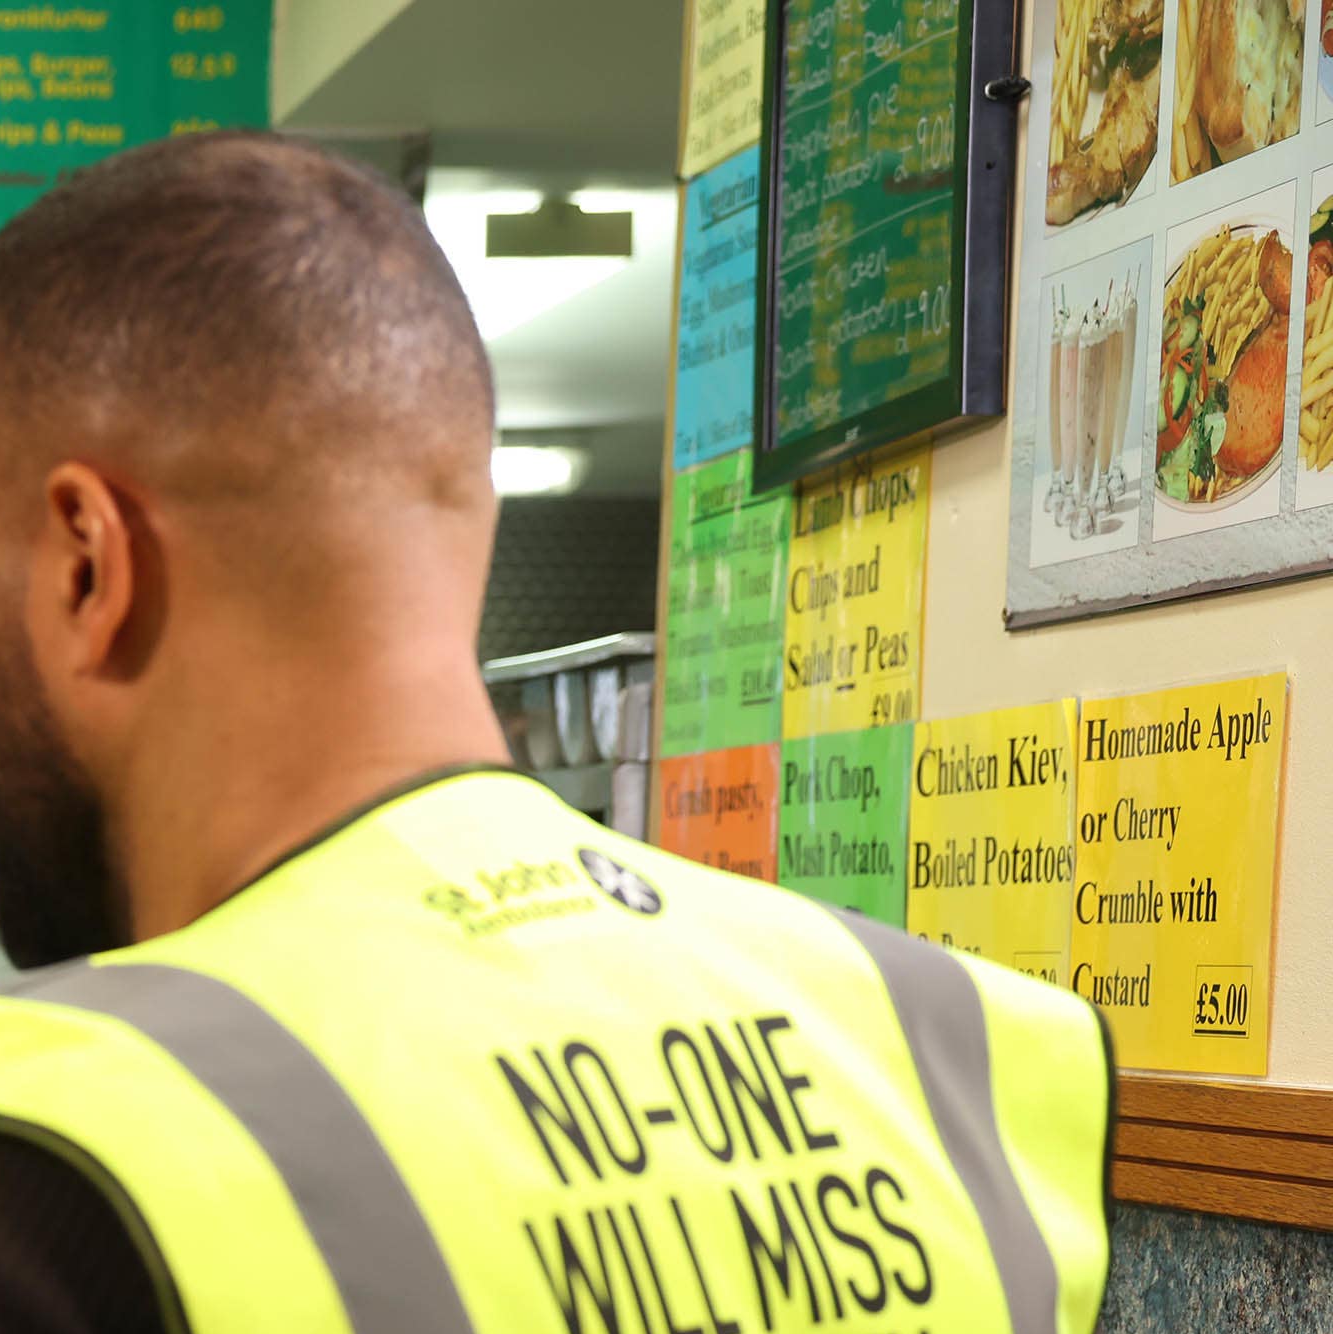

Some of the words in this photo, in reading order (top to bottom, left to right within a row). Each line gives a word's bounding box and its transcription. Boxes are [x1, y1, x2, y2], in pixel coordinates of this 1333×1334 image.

[791, 561, 839, 622] Chips
[843, 544, 881, 598] and
[786, 634, 833, 691] Salad
[836, 643, 859, 682] or
[864, 625, 910, 674] Peas
[1083, 707, 1201, 763] Homemade
[1206, 698, 1272, 762] Apple
[826, 754, 882, 813] Chop,
[916, 745, 999, 797] Chicken
[1006, 734, 1068, 795] Kiev,
[783, 834, 825, 879] Mash
[830, 831, 895, 877] Potato,
[1081, 810, 1108, 845] or
[1112, 797, 1182, 851] Cherry
[913, 838, 978, 889] Boiled
[983, 836, 1074, 886] Potatoes
[1076, 879, 1165, 925] Crumble
[1169, 876, 1218, 923] with
[1072, 962, 1152, 1008] Custard
[1194, 982, 1249, 1027] £5.00
[495, 1015, 841, 1187] NO-ONE
[728, 1166, 936, 1334] MISS
